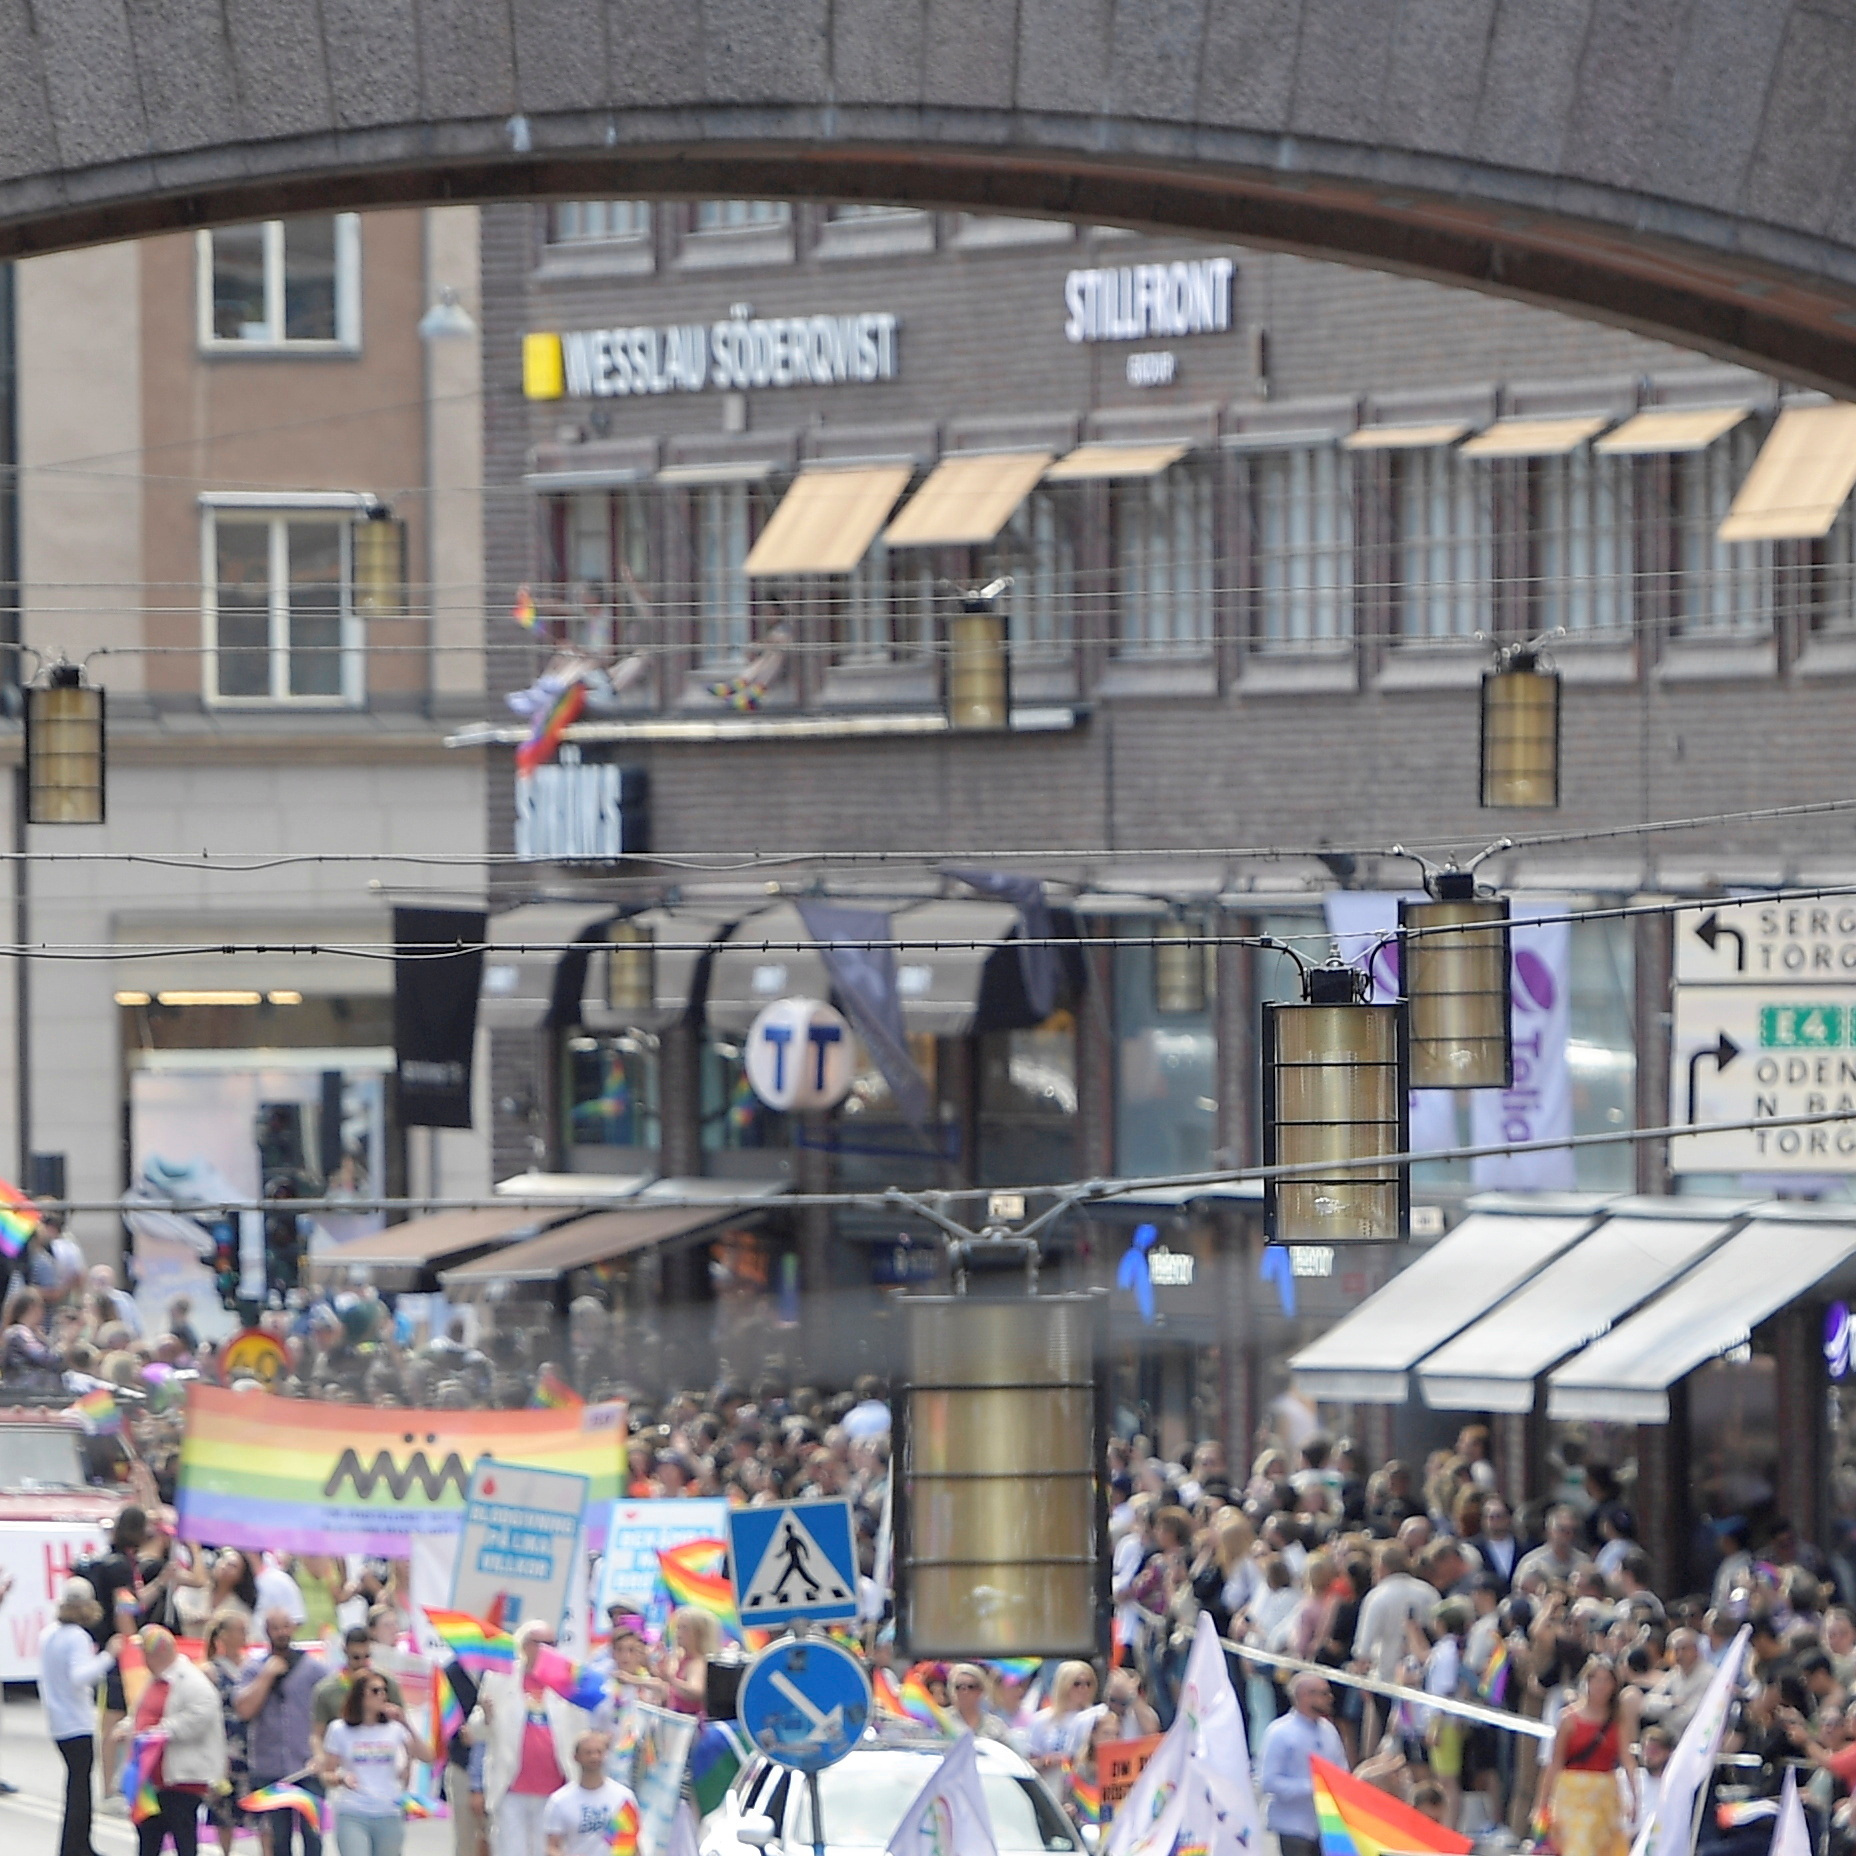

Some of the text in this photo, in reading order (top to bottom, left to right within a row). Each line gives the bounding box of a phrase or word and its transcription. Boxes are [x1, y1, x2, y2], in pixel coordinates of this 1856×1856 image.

[1065, 257, 1234, 344] STILLFRONT
[564, 301, 898, 397] WESSLAU SÖDERQVIST
[1775, 1009, 1828, 1041] E4
[1756, 1095, 1778, 1118] N
